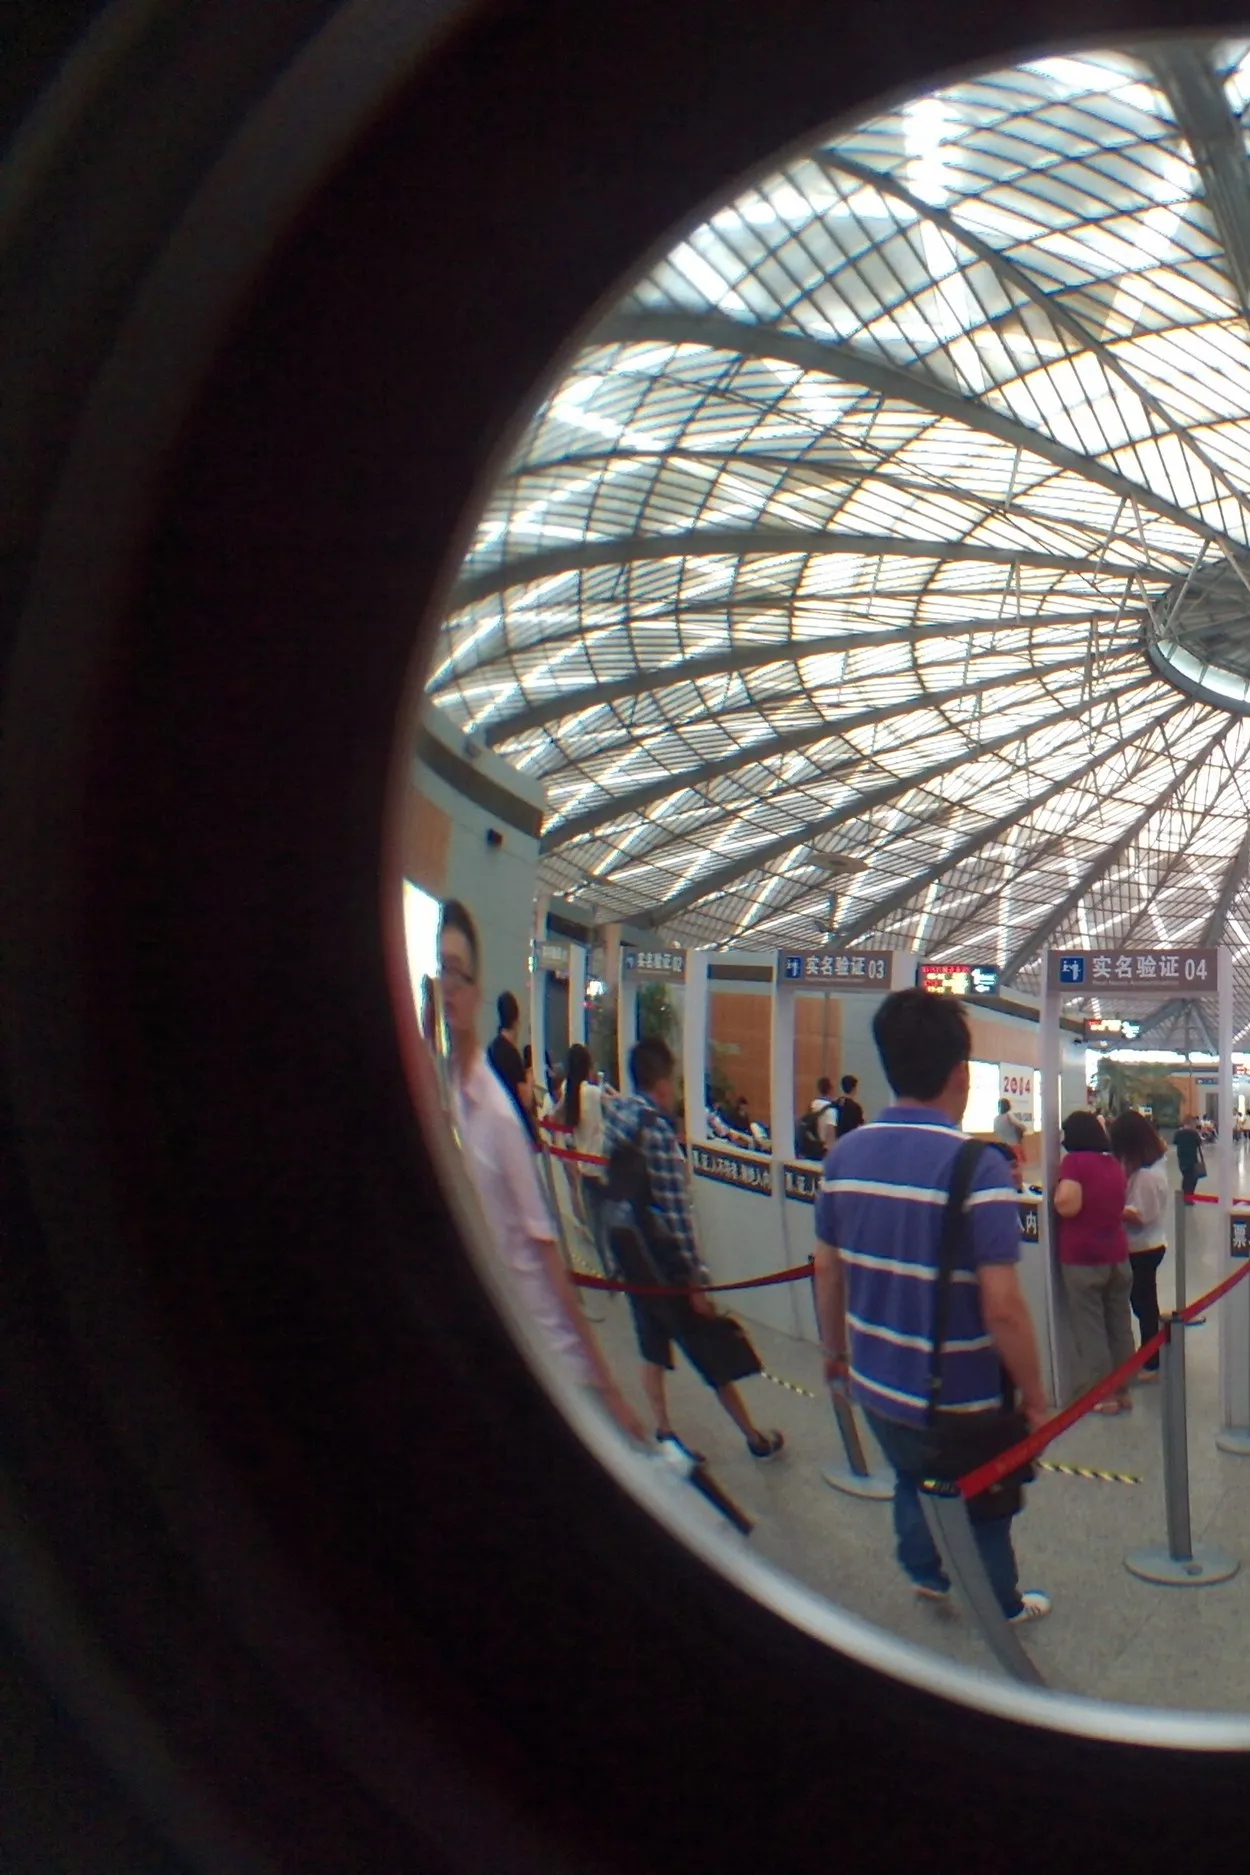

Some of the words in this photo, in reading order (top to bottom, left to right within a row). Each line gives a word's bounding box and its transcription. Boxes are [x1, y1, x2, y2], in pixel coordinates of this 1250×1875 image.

[806, 956, 866, 976] 实名验证
[868, 960, 884, 979] 03
[1092, 955, 1179, 978] 实名验证
[1184, 959, 1208, 981] 04
